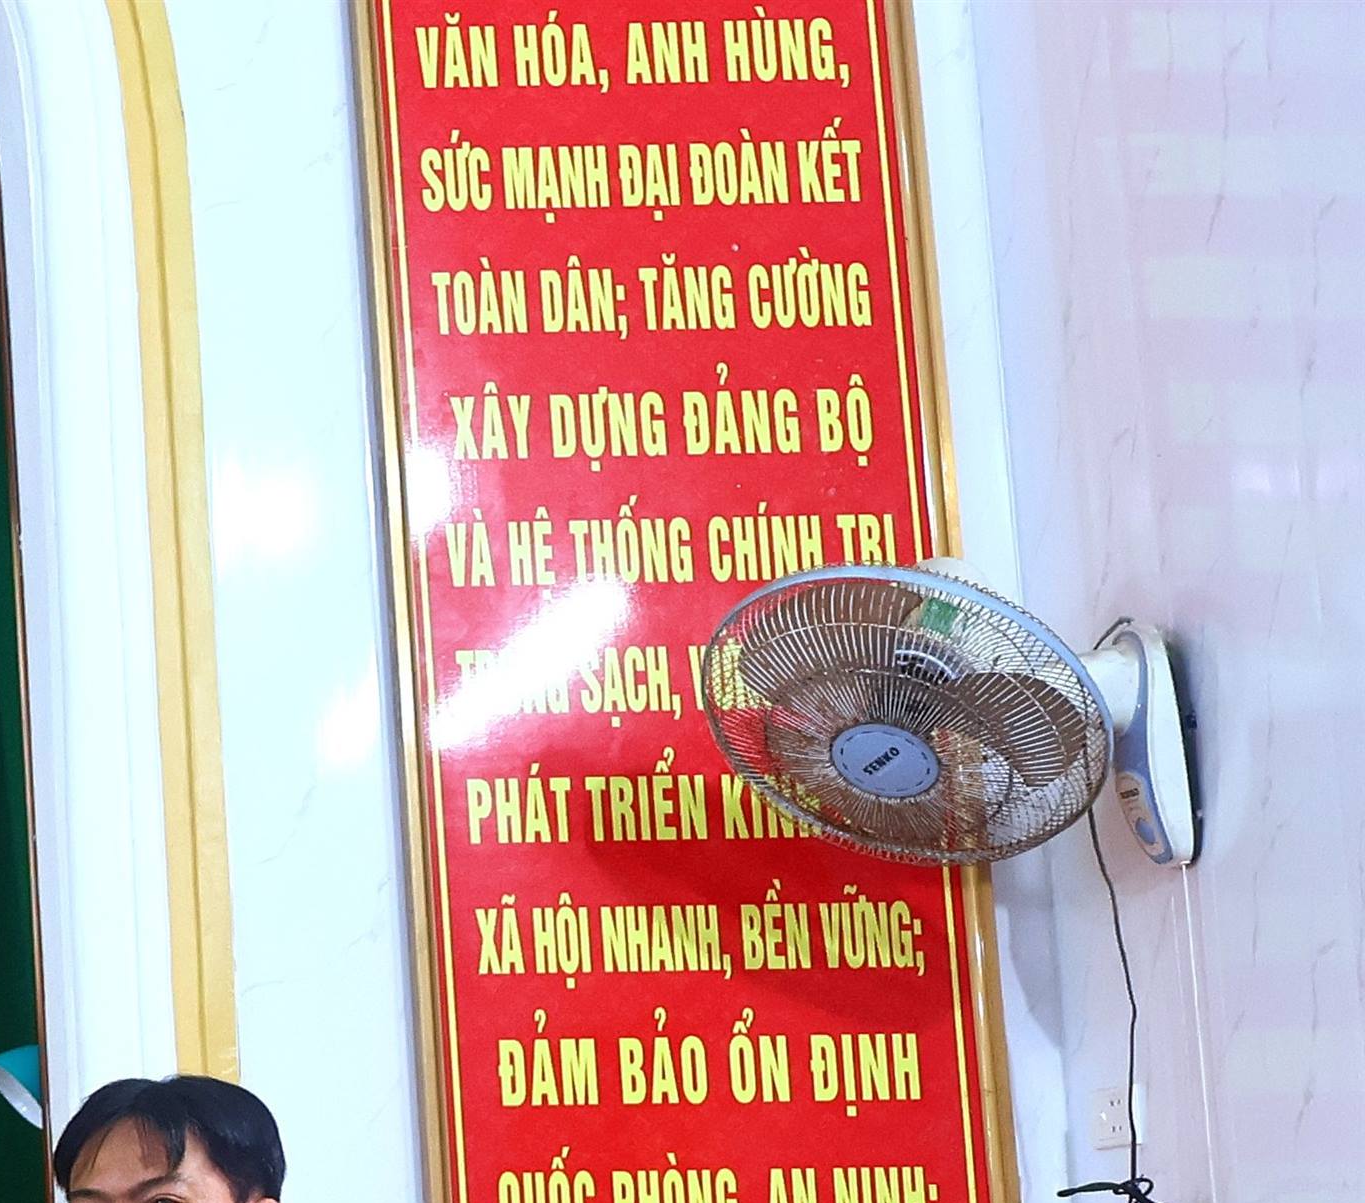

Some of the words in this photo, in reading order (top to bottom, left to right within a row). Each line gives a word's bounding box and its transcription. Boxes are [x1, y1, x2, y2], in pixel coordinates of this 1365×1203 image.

[415, 14, 497, 89] VĂN
[513, 11, 610, 93] HÓA,
[627, 21, 708, 83] ANH
[724, 4, 850, 88] HÙNG,
[421, 129, 491, 212] SỨC
[502, 145, 610, 223] MẠNH
[619, 142, 680, 220] ĐẠI
[689, 128, 789, 206] ĐOÀN
[797, 116, 861, 204] KẾT
[432, 259, 528, 335] TOÀN
[541, 256, 628, 339] DÂN;
[639, 253, 735, 331] TĂNG
[748, 247, 872, 328] CƯỜNG
[450, 382, 531, 460] XÂY
[550, 386, 666, 471] DỰNG
[683, 362, 800, 456] ĐẢNG
[817, 373, 873, 466] BỘ
[445, 508, 495, 587] VÀ
[508, 507, 556, 602] HỆ
[570, 495, 693, 585] THỐNG
[709, 502, 823, 582] CHÍNH
[580, 645, 682, 727] SẠCH,
[466, 763, 570, 843] PHÁT
[586, 746, 709, 841] TRIỂN
[862, 746, 900, 776] SENKO
[475, 895, 525, 974] XÃ
[532, 893, 591, 988] HỘI
[601, 904, 731, 978] NHANH,
[741, 879, 811, 971] BỀN
[819, 885, 925, 975] VỮNG;
[498, 1009, 599, 1107] ĐẢM
[619, 1007, 708, 1105] BẢO
[729, 1007, 791, 1104] ỔN
[810, 1033, 922, 1117] ĐỊNH
